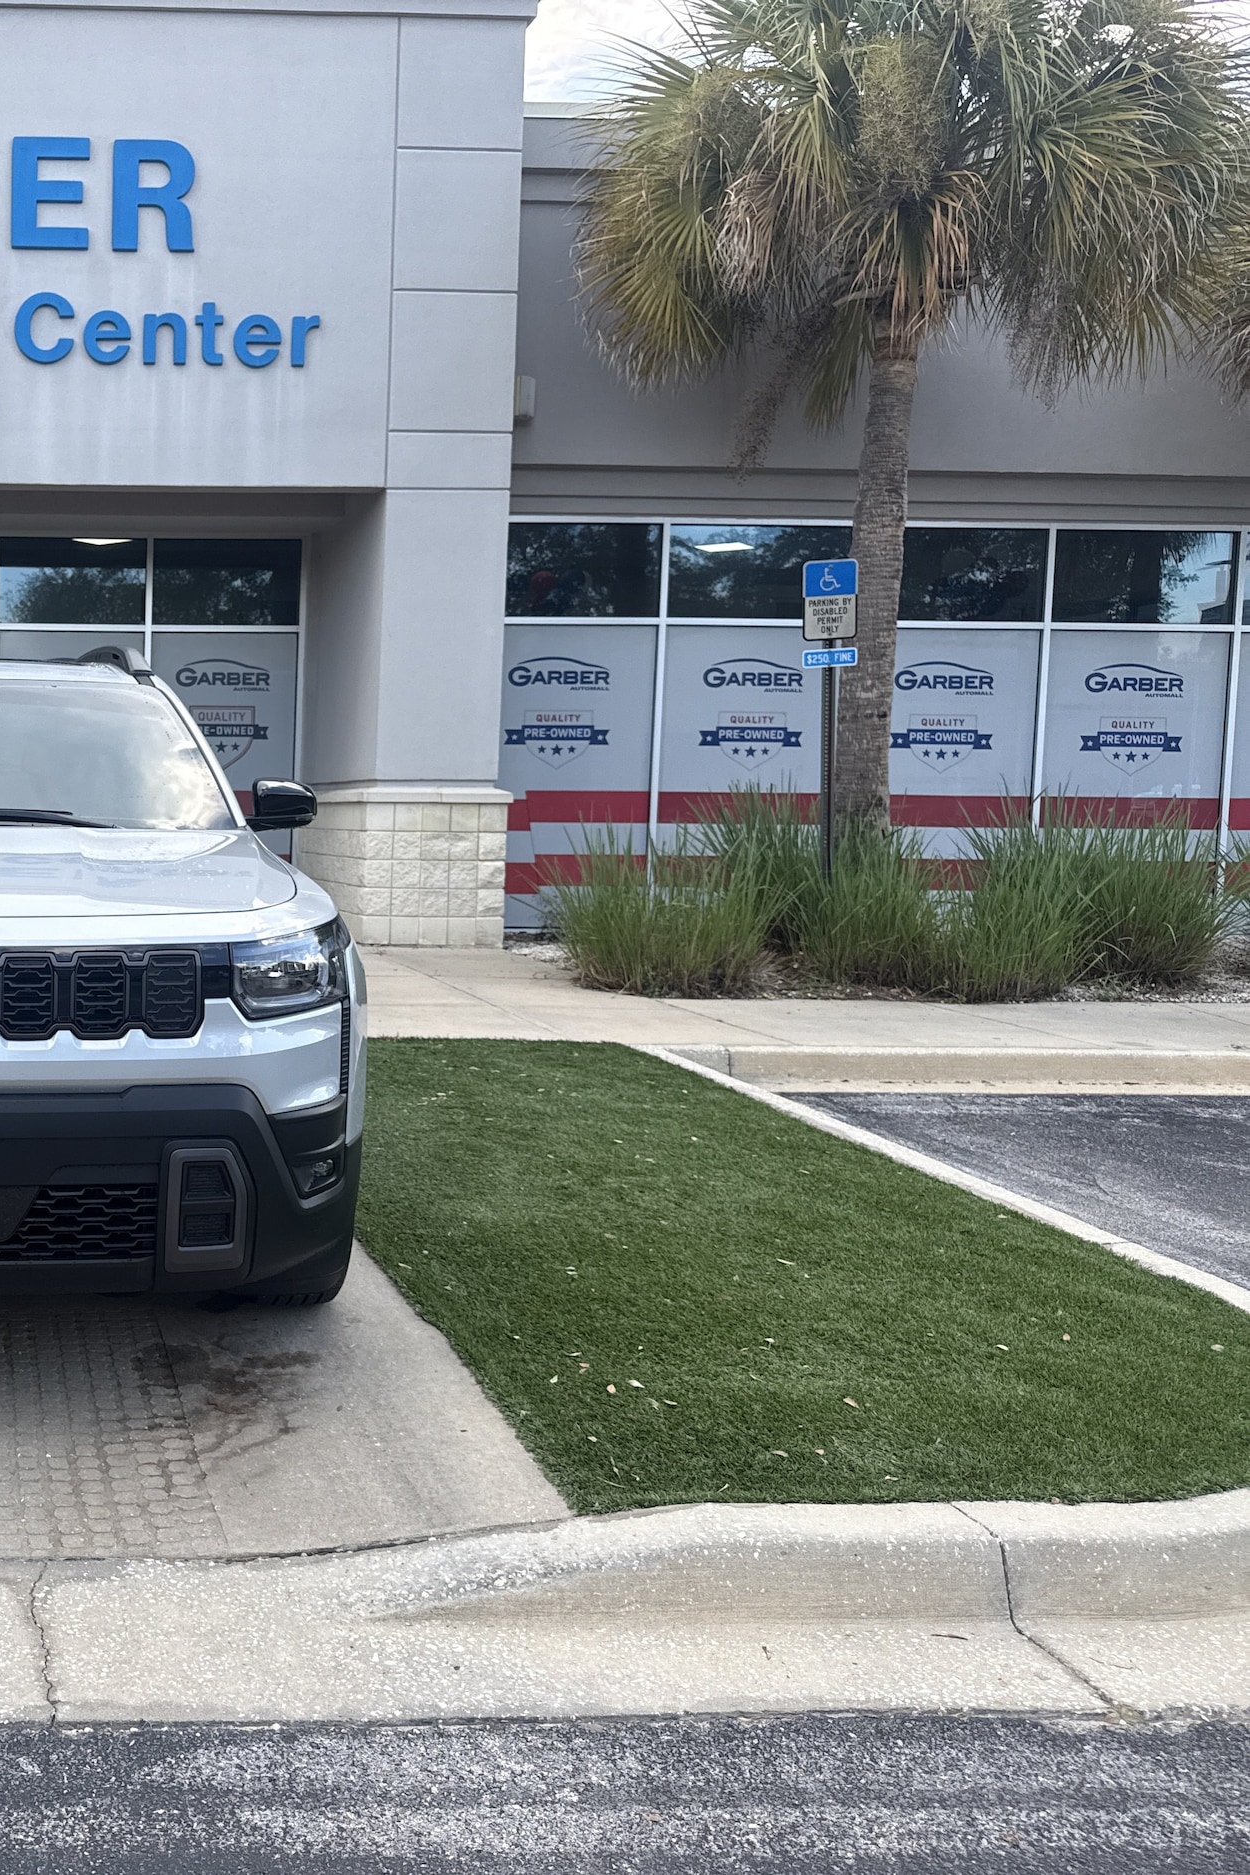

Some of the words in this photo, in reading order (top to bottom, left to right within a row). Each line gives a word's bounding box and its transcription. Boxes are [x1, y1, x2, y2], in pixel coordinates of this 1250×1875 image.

[13, 292, 321, 369] Center
[809, 599, 839, 607] PARKING
[813, 607, 848, 616] DISABLED
[817, 616, 843, 625] PERMIT
[821, 625, 839, 634] ONLY
[834, 652, 854, 662] FINE
[175, 667, 270, 687] GARBER
[508, 666, 610, 687] GARBER
[703, 667, 803, 688] GARBER
[894, 670, 994, 691] GARBER
[1085, 672, 1184, 693] GARBER
[198, 711, 246, 722] QUALITY
[535, 714, 581, 723] QUALITY
[730, 715, 775, 725] QUALITY
[921, 718, 965, 727] QUALITY
[1111, 721, 1155, 730] QUALITY
[201, 725, 254, 736] E-OWNED
[524, 728, 591, 738] PRE-OWNED
[718, 729, 785, 740] PRE-OWNED
[909, 732, 975, 742] PRE-OWNED
[1099, 734, 1165, 745] PRE-OWNED
